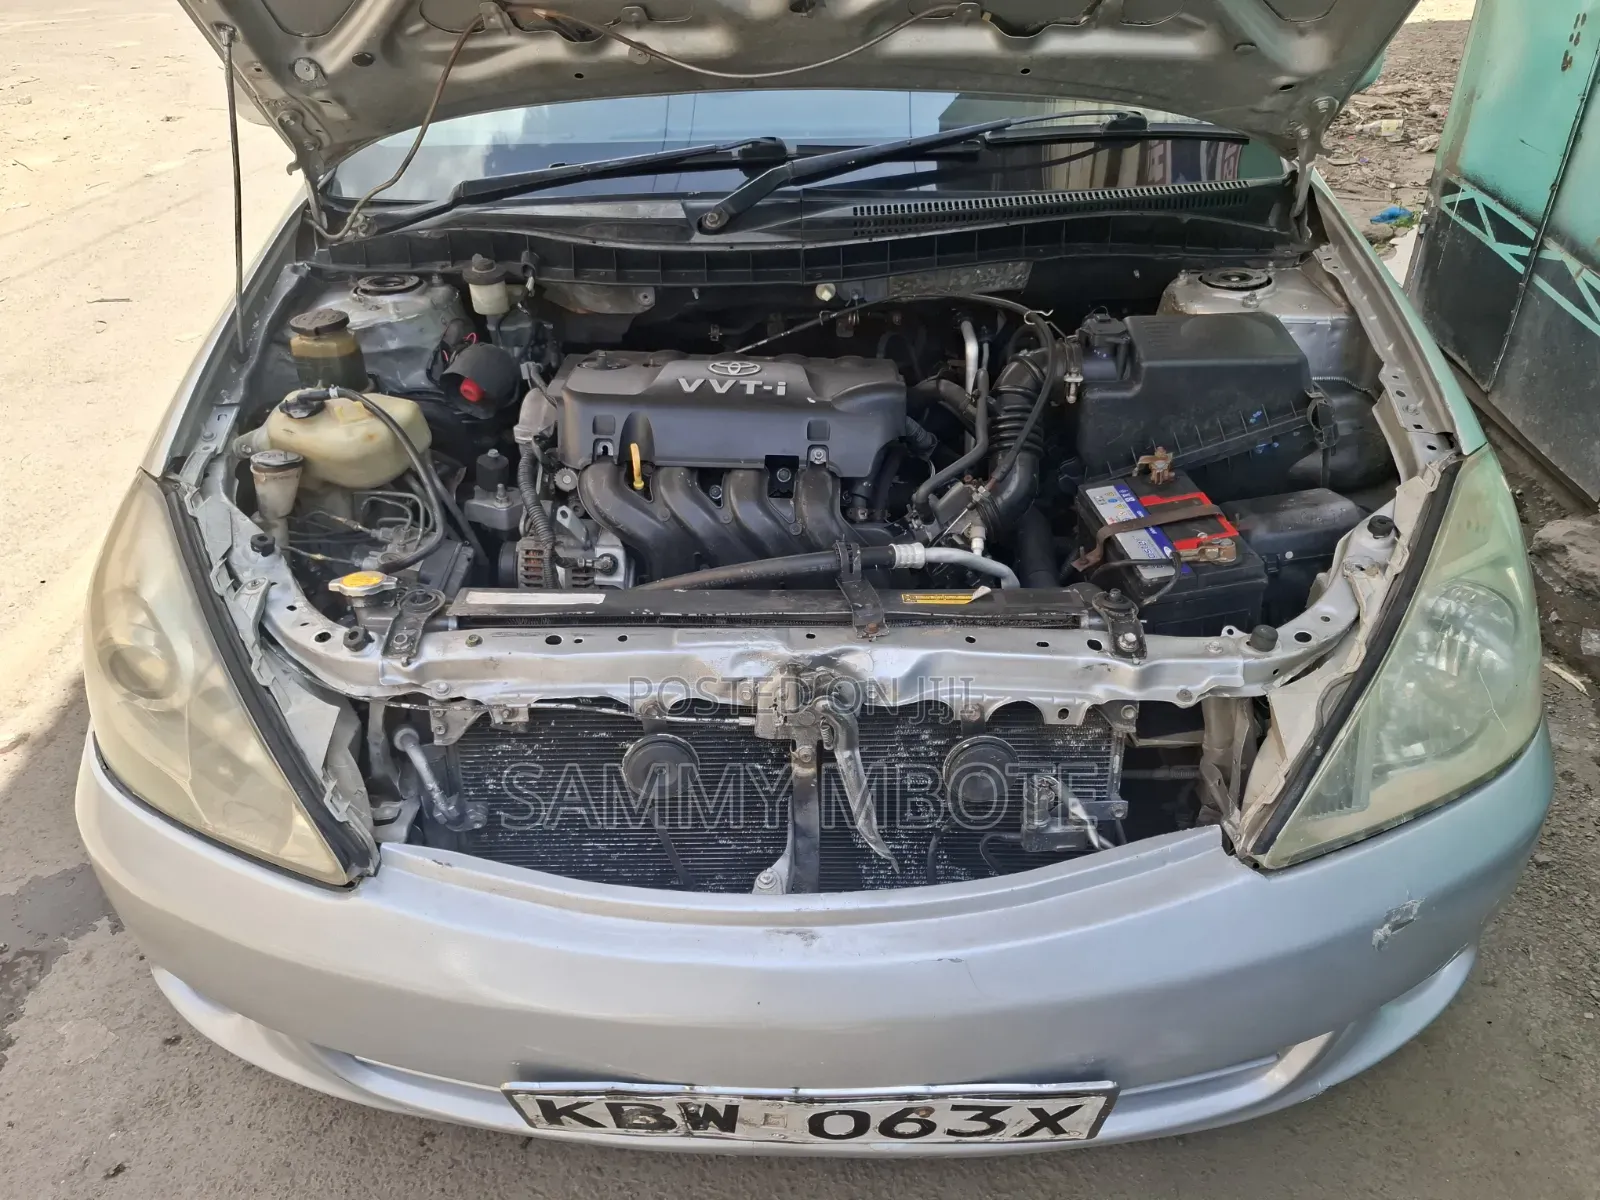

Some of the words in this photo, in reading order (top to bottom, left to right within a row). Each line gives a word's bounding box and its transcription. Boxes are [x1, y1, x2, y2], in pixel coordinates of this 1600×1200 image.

[678, 378, 786, 395] VVT-i
[535, 1099, 740, 1133] KBW
[808, 1104, 1084, 1140] 063X
